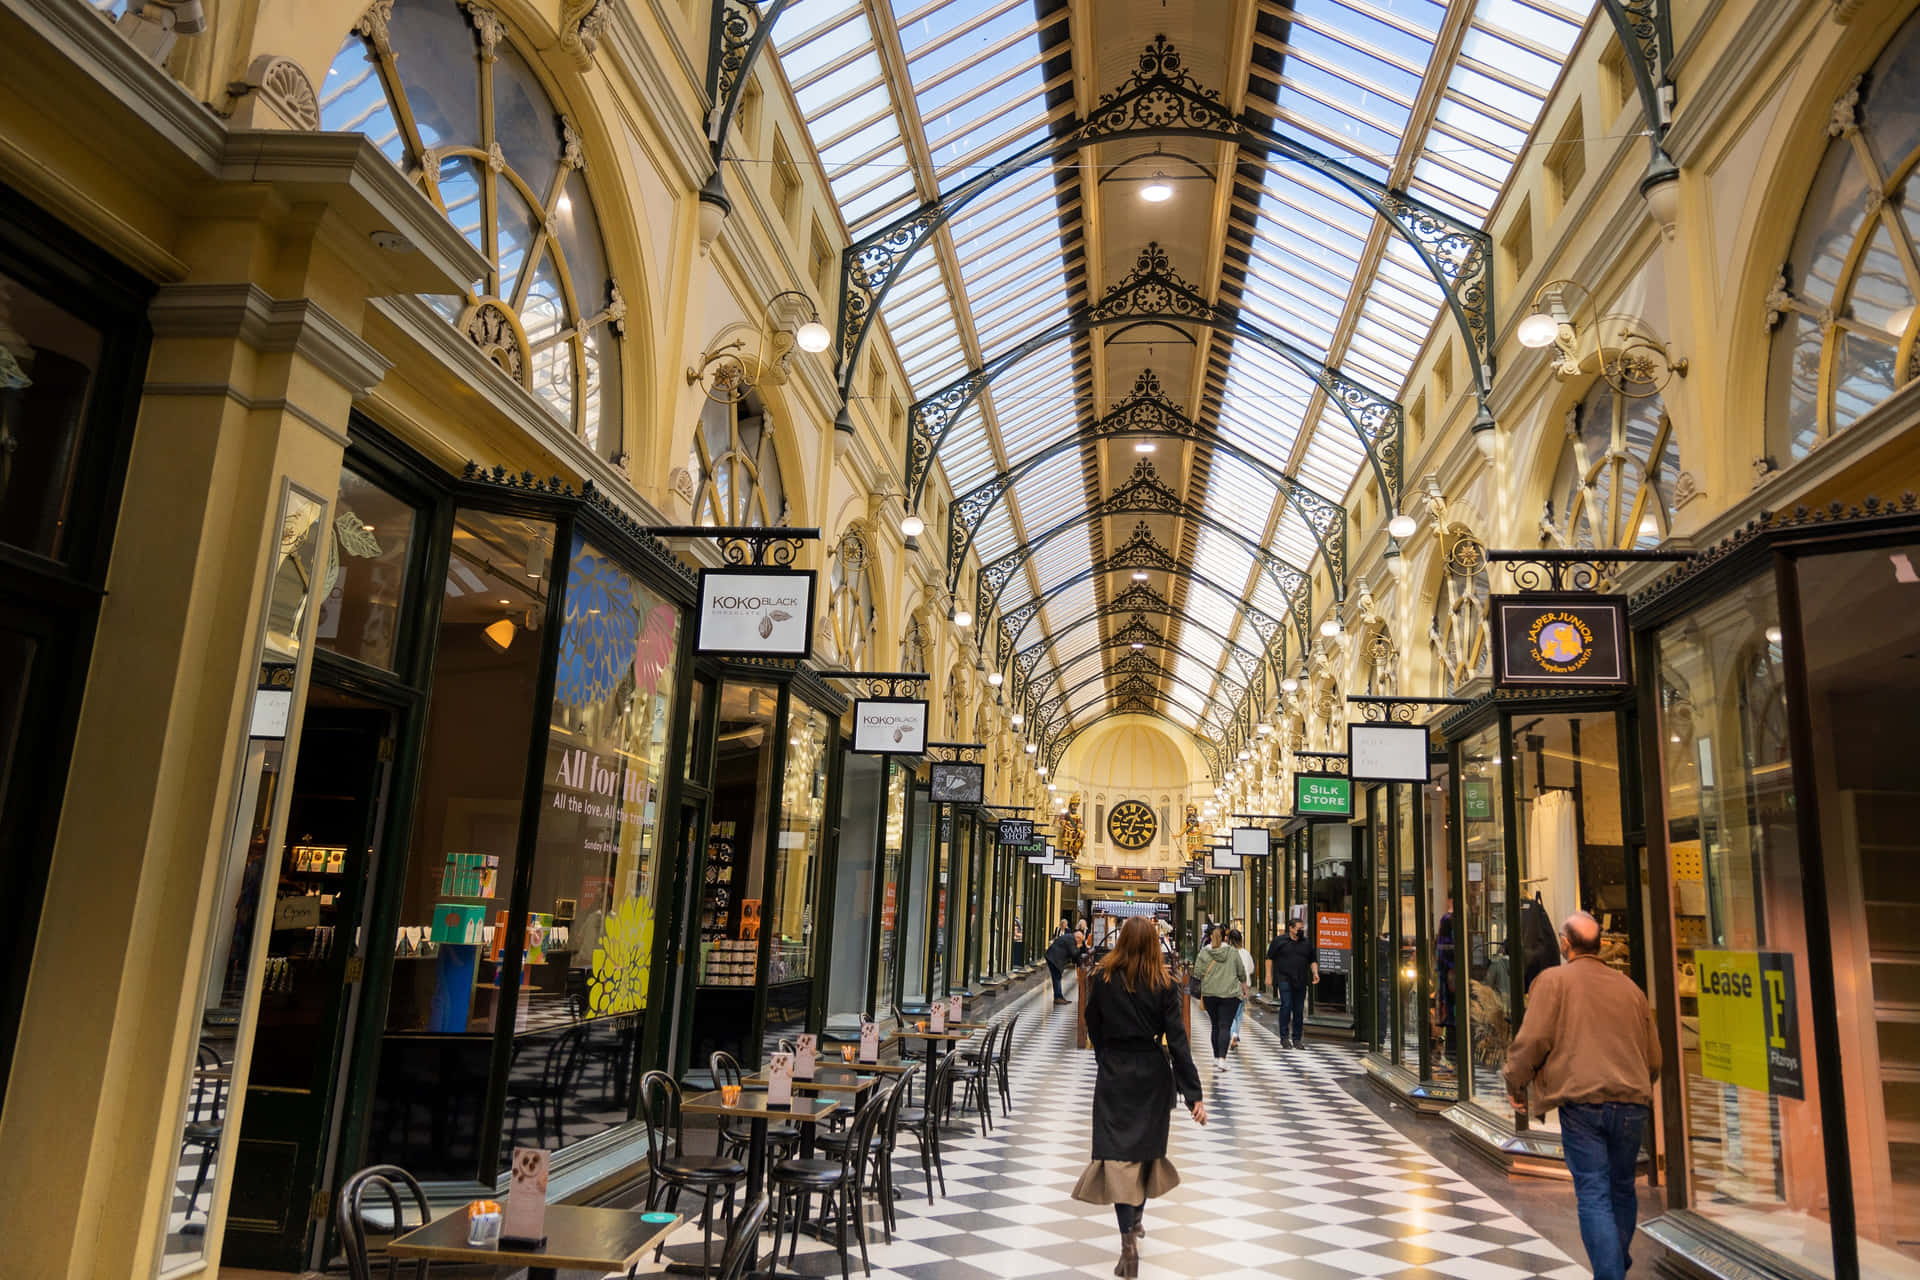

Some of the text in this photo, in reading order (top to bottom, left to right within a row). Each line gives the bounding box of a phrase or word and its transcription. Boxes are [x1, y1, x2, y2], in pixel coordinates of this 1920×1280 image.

[712, 596, 798, 610] KOKO BLACK
[1528, 612, 1593, 645] JASPER JUNIOR
[863, 716, 895, 725] KOKO
[556, 748, 588, 789] All
[590, 755, 620, 798] for
[1310, 784, 1339, 795] SILK
[553, 792, 566, 809] All
[568, 796, 582, 813] the
[584, 799, 603, 817] love.
[604, 804, 616, 820] All
[1303, 794, 1345, 806] STORE
[1000, 825, 1032, 834] GAMES
[1003, 832, 1029, 841] SHOP
[1700, 963, 1753, 998] Lease
